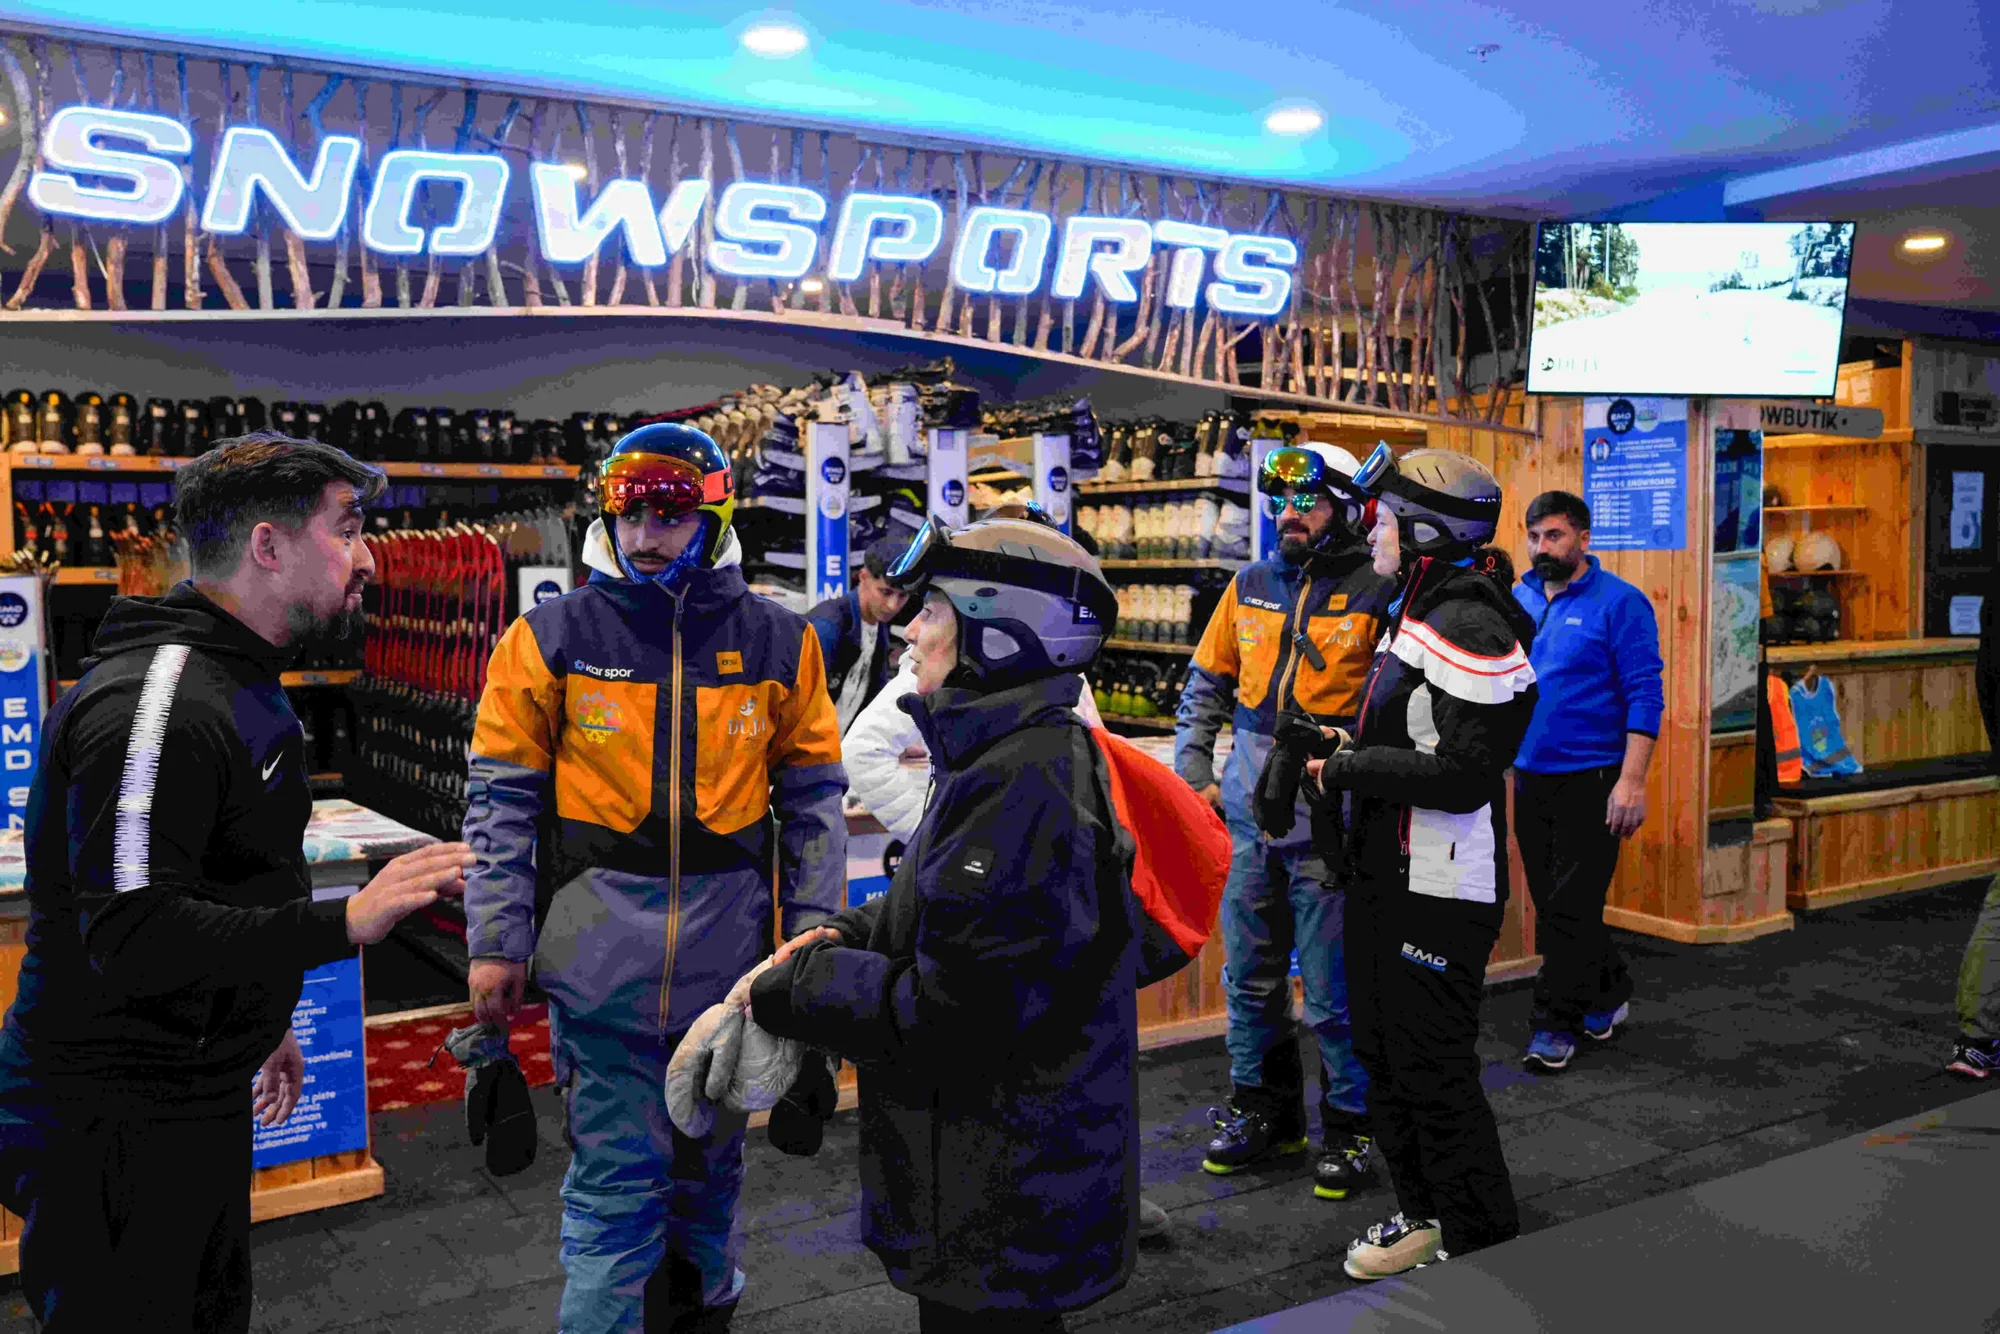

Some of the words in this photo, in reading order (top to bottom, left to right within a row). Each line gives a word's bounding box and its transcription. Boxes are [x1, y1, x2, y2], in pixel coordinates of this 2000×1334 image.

[28, 104, 1301, 317] SNOWSPORTS
[585, 663, 603, 676] kar
[604, 667, 632, 680] spor
[1402, 942, 1448, 967] EMD
